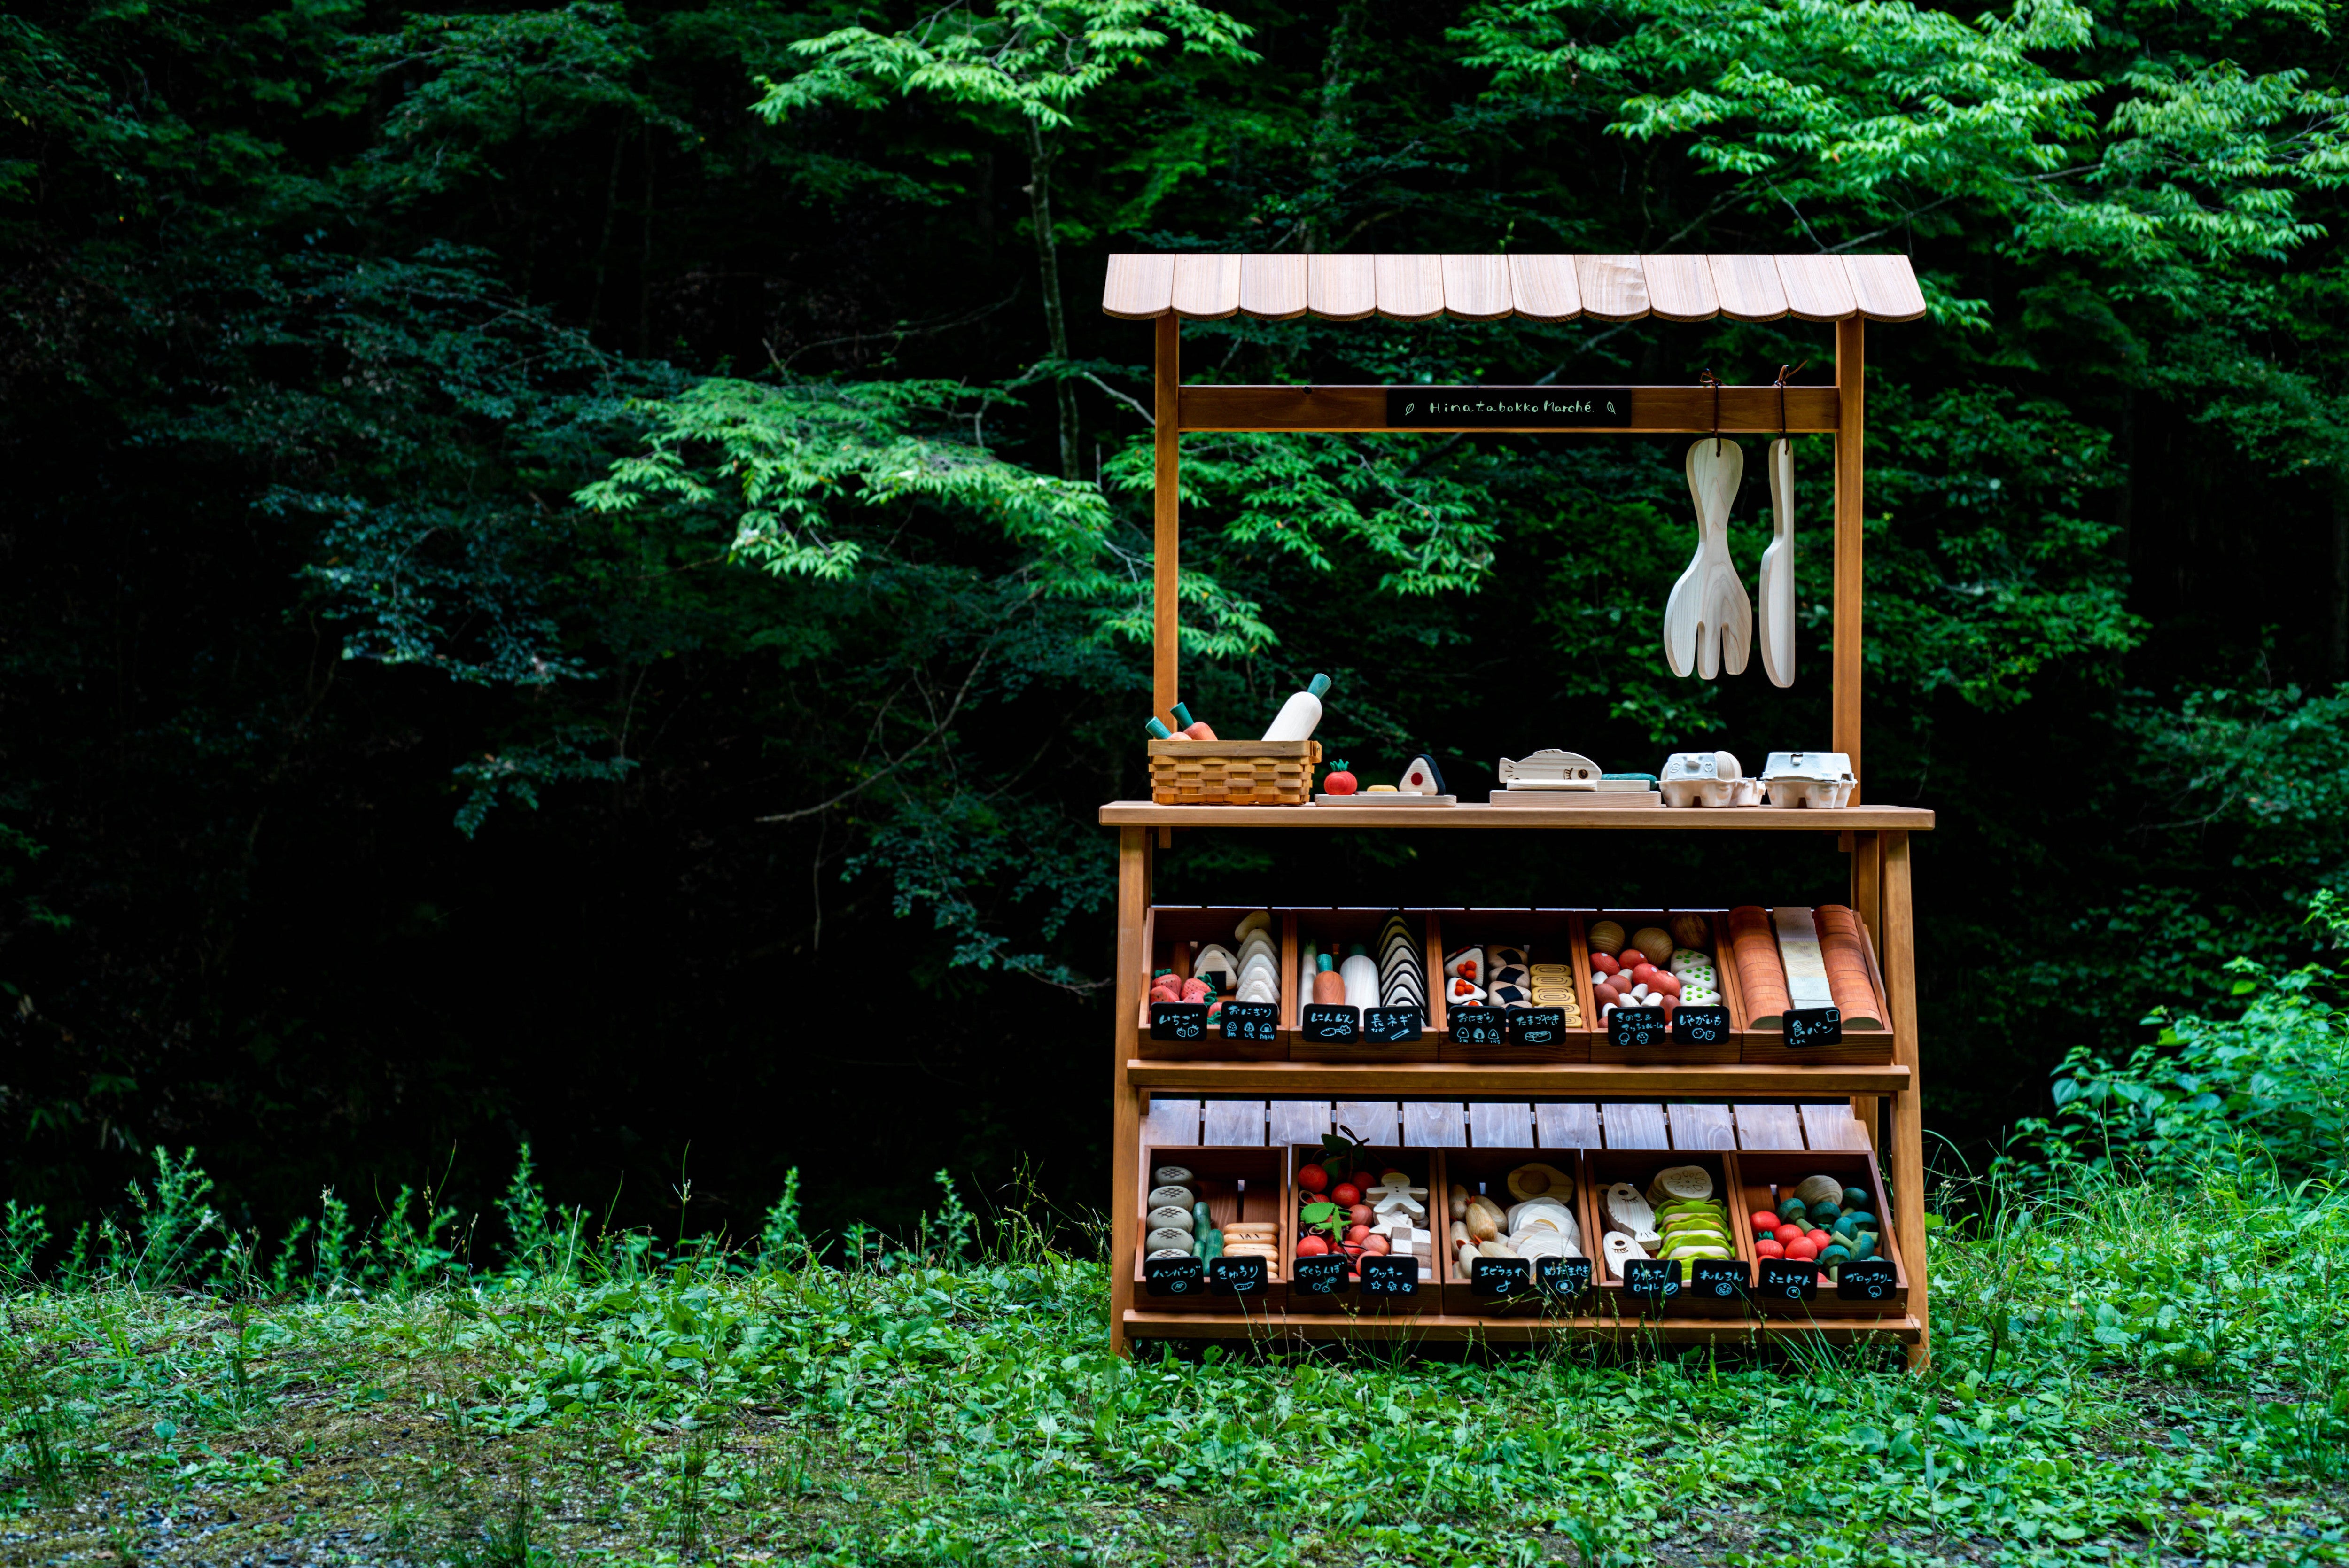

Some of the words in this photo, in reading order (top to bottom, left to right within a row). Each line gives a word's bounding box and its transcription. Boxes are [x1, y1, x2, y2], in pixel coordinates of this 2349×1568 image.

[1429, 400, 1539, 413] Hinatabokko
[1228, 1005, 1271, 1018] おにぎり
[1616, 1012, 1642, 1023] きのこ
[1159, 1013, 1198, 1025] いちご
[1311, 1012, 1354, 1024] にんじん
[1371, 1013, 1413, 1027] 長ネギ
[1457, 1012, 1494, 1024] おにぎり
[1516, 1014, 1559, 1026] たまごやき
[1680, 1014, 1722, 1026] じゃがいも
[1792, 1020, 1833, 1037] 食パン
[1152, 1265, 1201, 1278] ハンバーグ
[1217, 1265, 1258, 1279] きゅうり
[1299, 1261, 1345, 1277] さくらんぼ
[1369, 1267, 1403, 1278] クッキー
[1480, 1265, 1522, 1277] エビフライ
[1544, 1265, 1589, 1277] めだまやき
[1700, 1270, 1744, 1281] れんこん
[1769, 1271, 1810, 1286] ミニトマト
[1845, 1273, 1892, 1284] ブロッコリー
[1633, 1283, 1659, 1292] ロール
